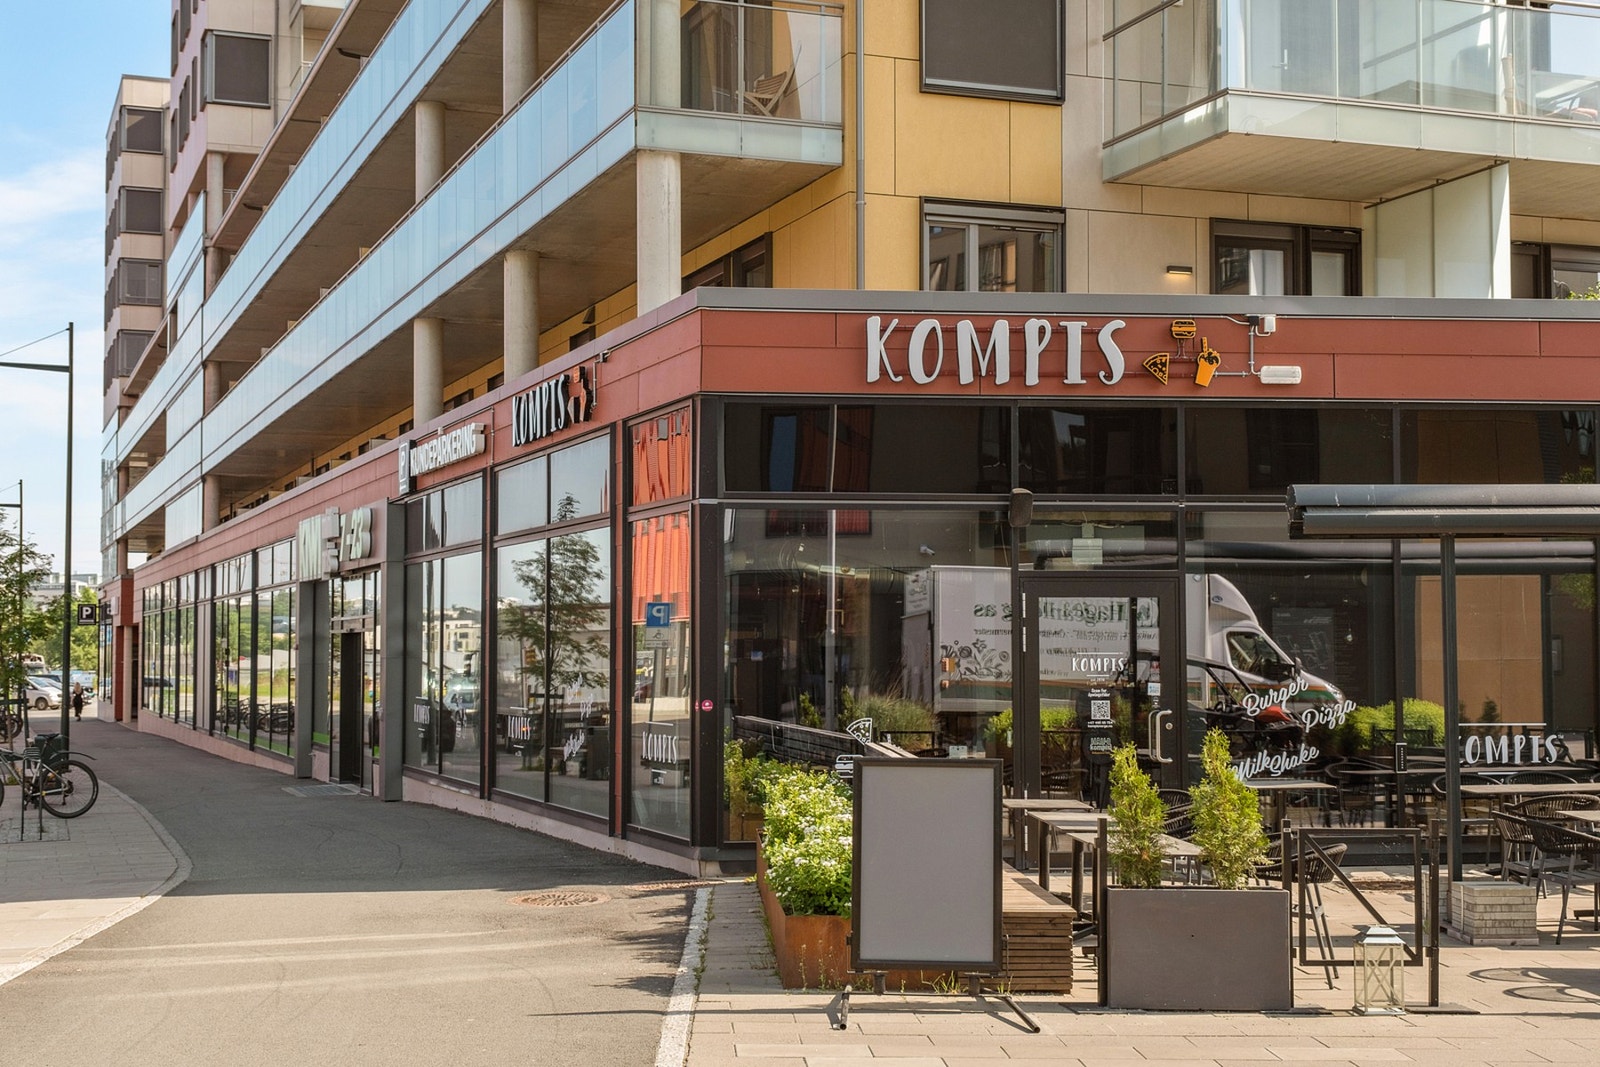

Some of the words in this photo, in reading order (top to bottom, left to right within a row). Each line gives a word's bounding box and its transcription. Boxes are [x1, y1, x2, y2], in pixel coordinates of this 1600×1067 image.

[866, 316, 1126, 385] KOMPIS
[512, 374, 566, 447] KOMPIS
[410, 423, 477, 477] KUNDEPARKERING
[82, 607, 92, 619] P
[1072, 657, 1125, 672] KOMPIS
[1242, 676, 1309, 717] Burger
[1301, 700, 1357, 733] Pizza
[642, 731, 677, 764] KOMPIS
[1459, 734, 1558, 764] OMPIS
